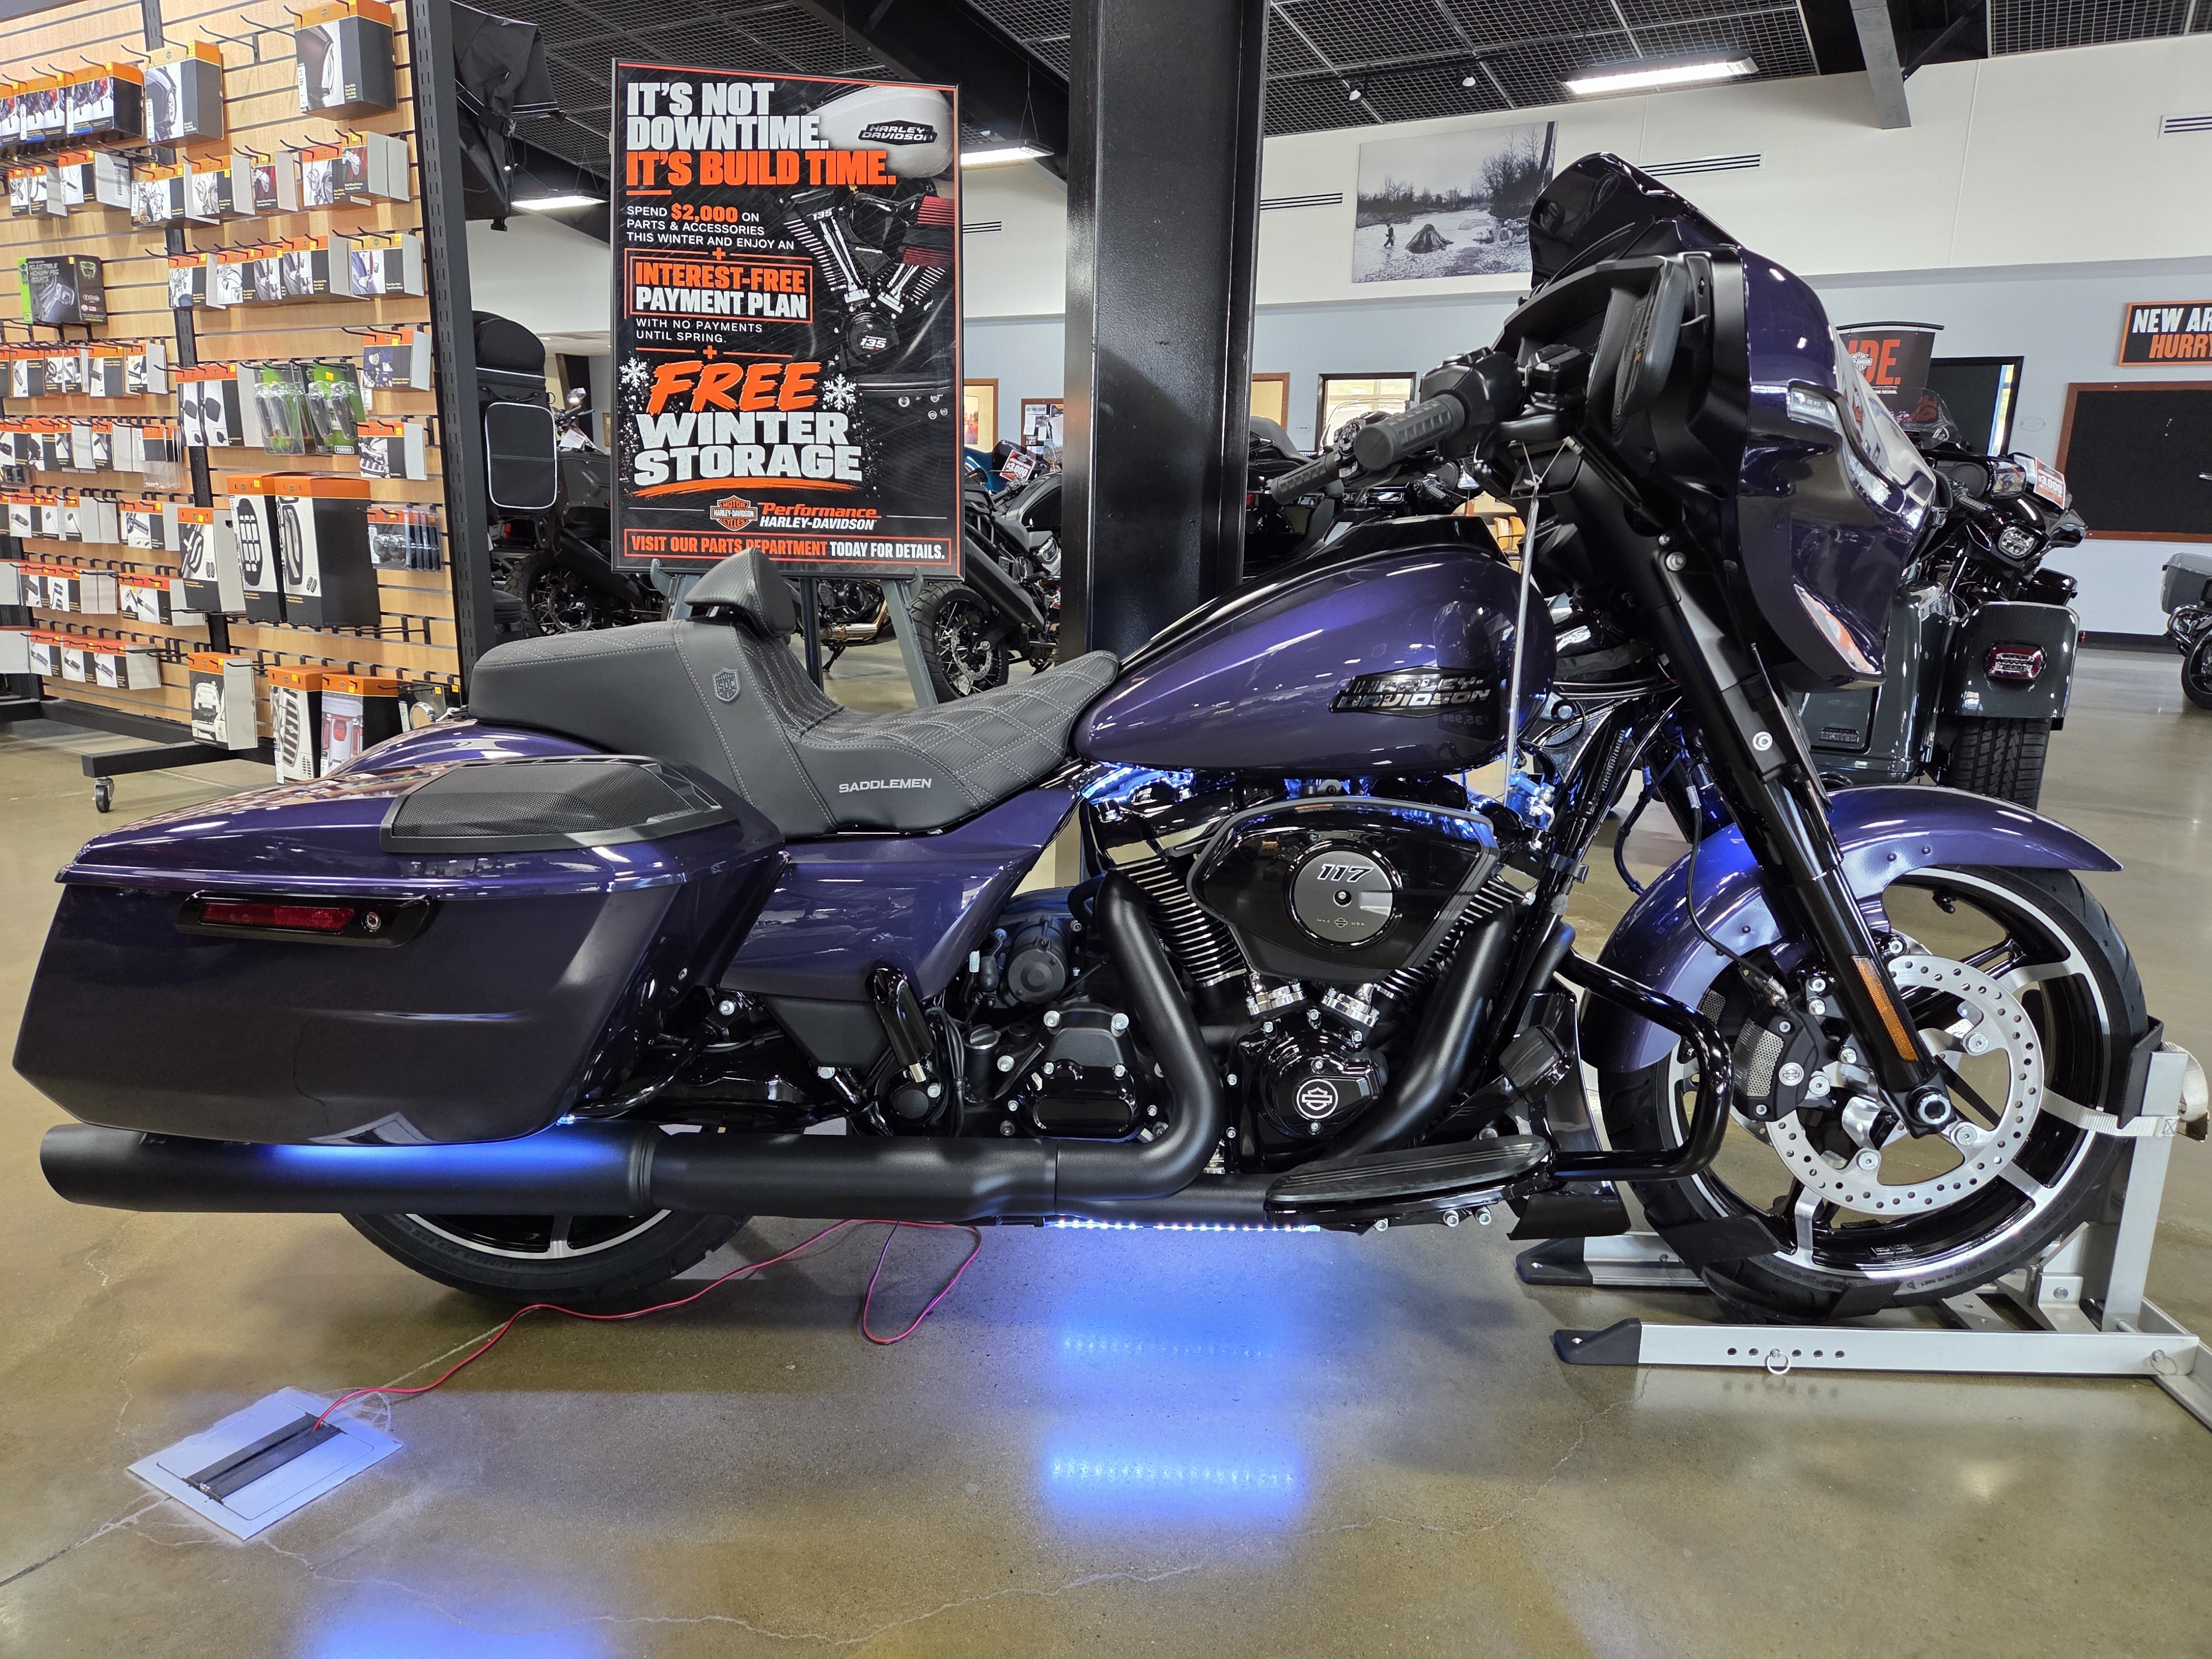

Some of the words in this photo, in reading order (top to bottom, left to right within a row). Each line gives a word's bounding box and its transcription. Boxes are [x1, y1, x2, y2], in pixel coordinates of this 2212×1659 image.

[627, 82, 693, 115] IT'S
[702, 82, 775, 115] NOT
[627, 116, 829, 150] DOWNTIME.
[626, 151, 692, 185] IT'S
[700, 151, 800, 185] BUILD
[805, 150, 896, 185] TIME.
[627, 206, 667, 217] SPEND
[671, 204, 738, 222] $2,000
[742, 212, 759, 222] ON
[813, 210, 832, 221] 135
[627, 220, 665, 230] PARTS
[670, 221, 679, 231] &
[682, 222, 765, 236] ACCESSORIES
[627, 232, 654, 243] THIS
[657, 234, 704, 245] WINTER
[707, 236, 732, 247] AND
[736, 238, 775, 249] ENJOY
[778, 240, 795, 250] AN
[636, 262, 805, 293] INTEREST-FREE
[636, 287, 745, 316] PAYMENT
[748, 294, 807, 319] PLAN
[636, 318, 668, 330] WITH
[673, 320, 690, 330] NO
[696, 320, 763, 333] PAYMENTS
[2132, 308, 2184, 333] NEW
[636, 330, 672, 341] UNTIL
[677, 332, 727, 343] SPRING.
[860, 338, 886, 348] 135
[2149, 334, 2212, 358] HURR
[646, 360, 821, 415] FREE
[635, 411, 849, 449] WINTER
[634, 445, 863, 486] STORAGE
[714, 509, 754, 518] HARLEY-DAVIDSON
[758, 502, 882, 518] Performance
[720, 518, 746, 528] CYCLES
[760, 516, 877, 530] HARLEY-DAVIDSON
[632, 535, 665, 552] VISIT
[670, 537, 698, 552] OUR
[702, 538, 742, 553] PARTS
[746, 539, 827, 556] DEPARTMENT
[830, 541, 868, 556] TODAY
[871, 542, 893, 557] FOR
[896, 543, 945, 559] DETAILS.
[1337, 689, 1490, 708] DAVIDSON
[839, 779, 932, 793] SADDLEMEN
[1317, 864, 1374, 882] 117
